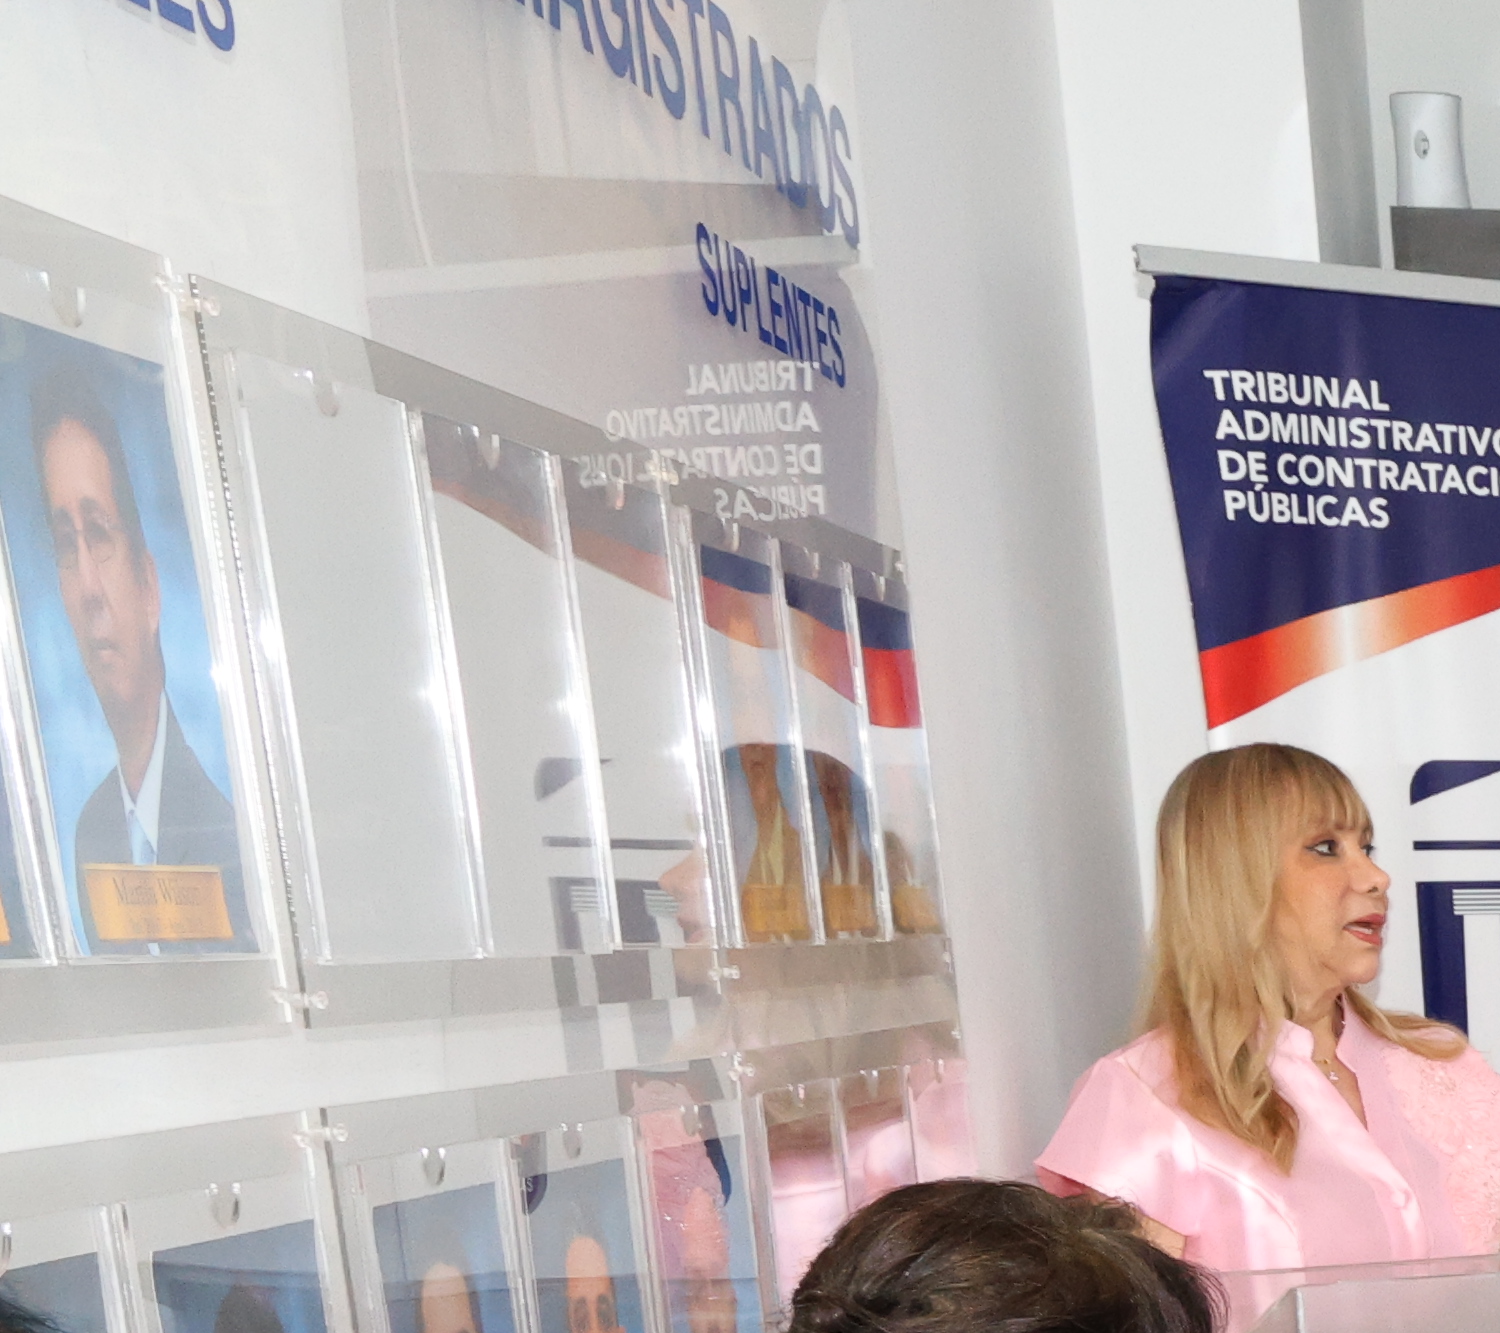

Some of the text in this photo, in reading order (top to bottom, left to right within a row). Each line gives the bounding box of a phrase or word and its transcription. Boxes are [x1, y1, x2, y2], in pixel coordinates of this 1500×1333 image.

[516, 0, 860, 250] GISTRADOS
[696, 222, 846, 388] SUPLENTES
[1203, 368, 1391, 412] TRIBUNAL
[1216, 448, 1269, 484] DE
[1223, 482, 1391, 530] PÚBLICAS
